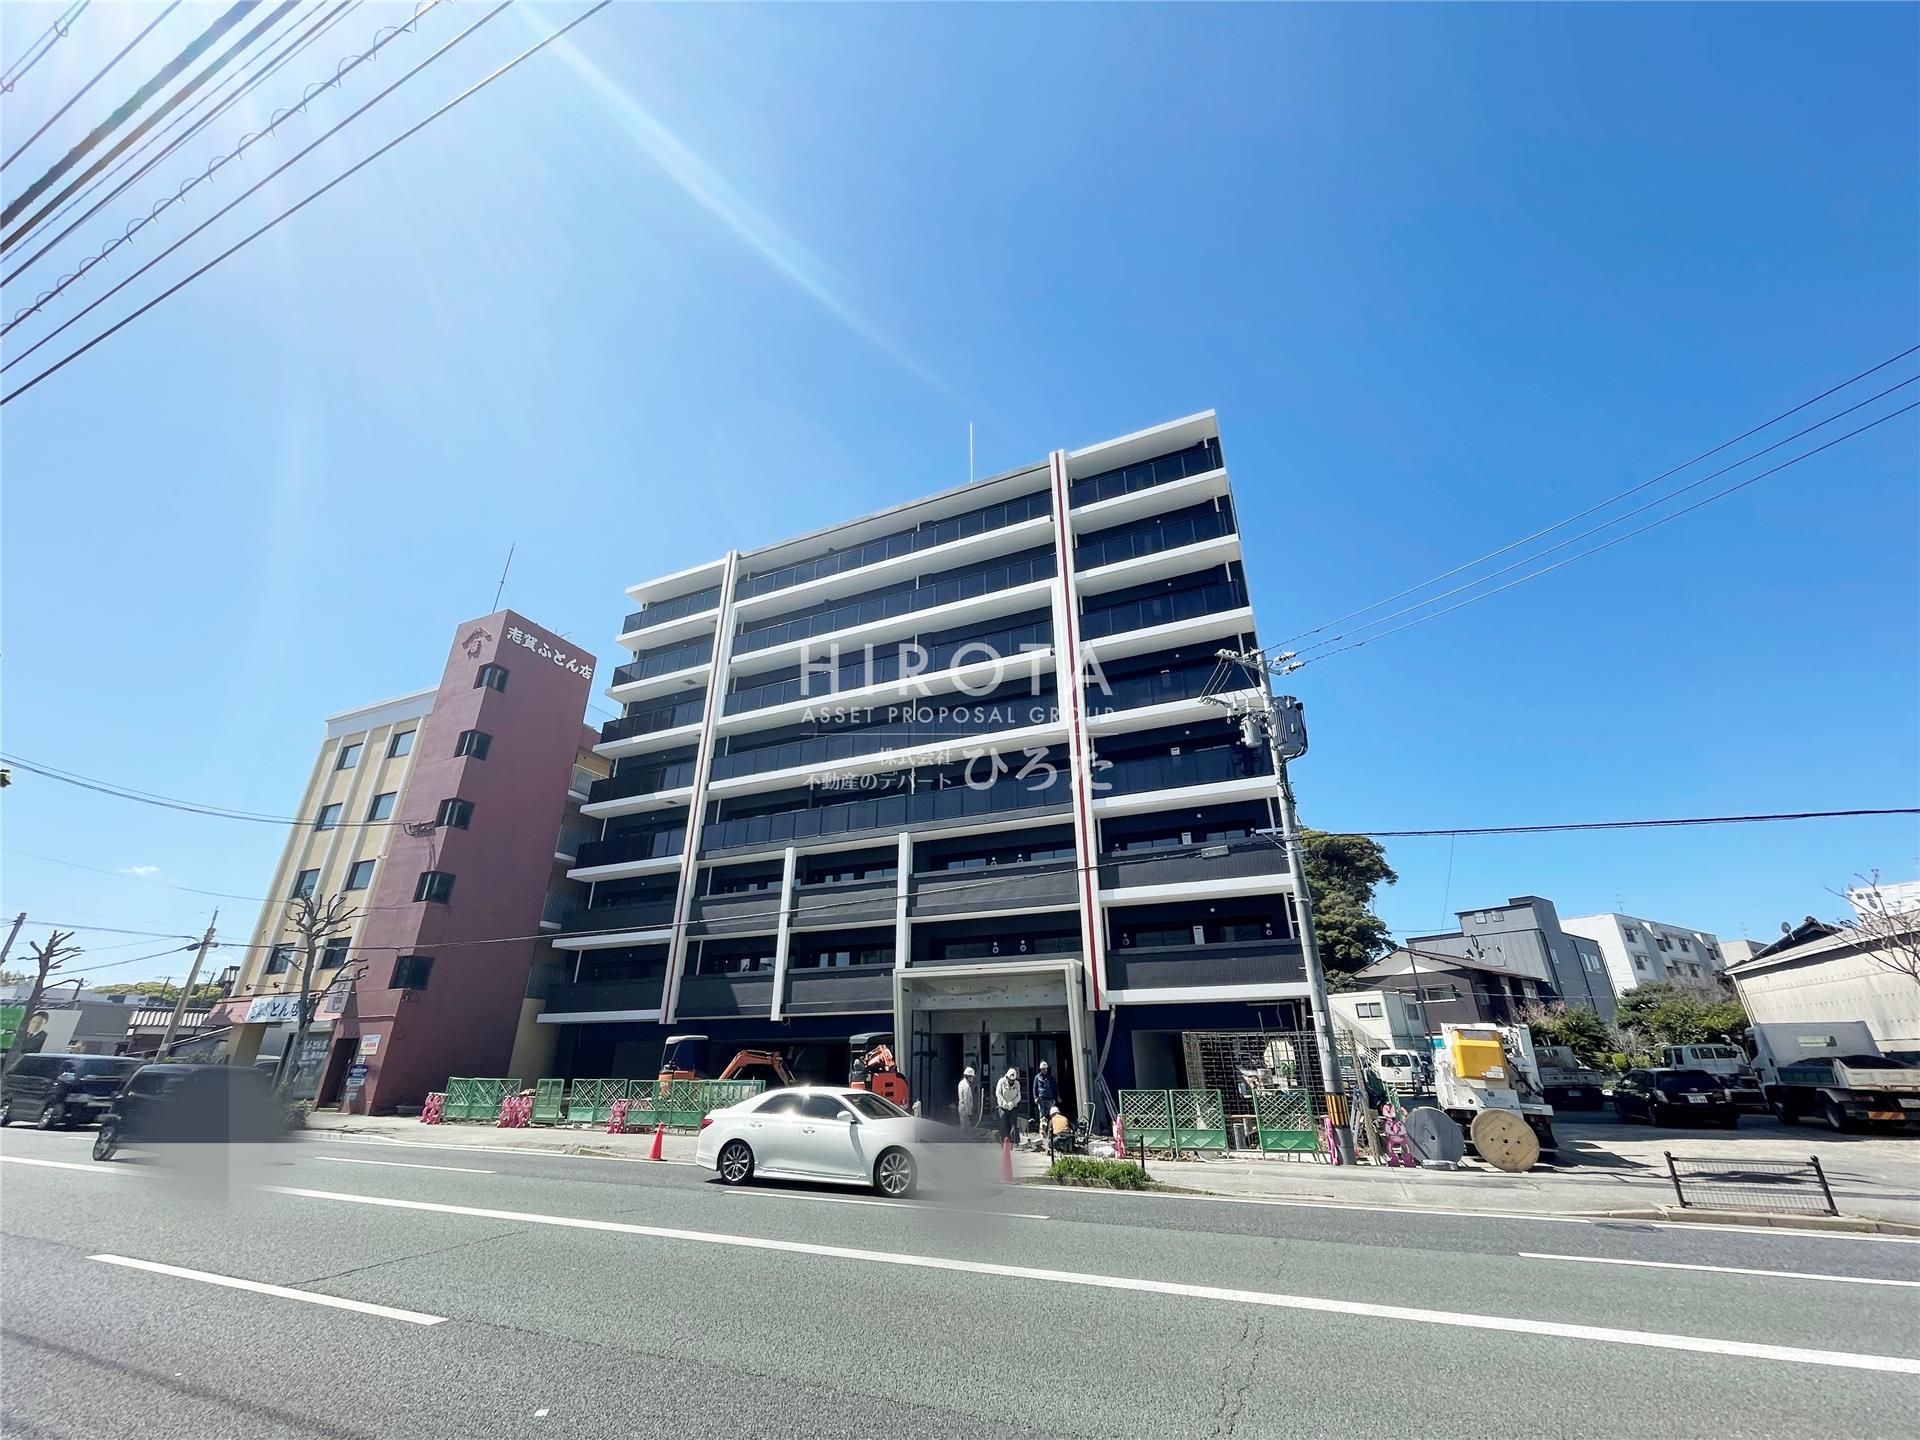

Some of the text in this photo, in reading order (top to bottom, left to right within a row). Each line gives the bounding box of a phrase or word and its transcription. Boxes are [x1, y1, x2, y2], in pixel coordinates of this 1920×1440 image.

[507, 627, 593, 680] 志賀ふとん店
